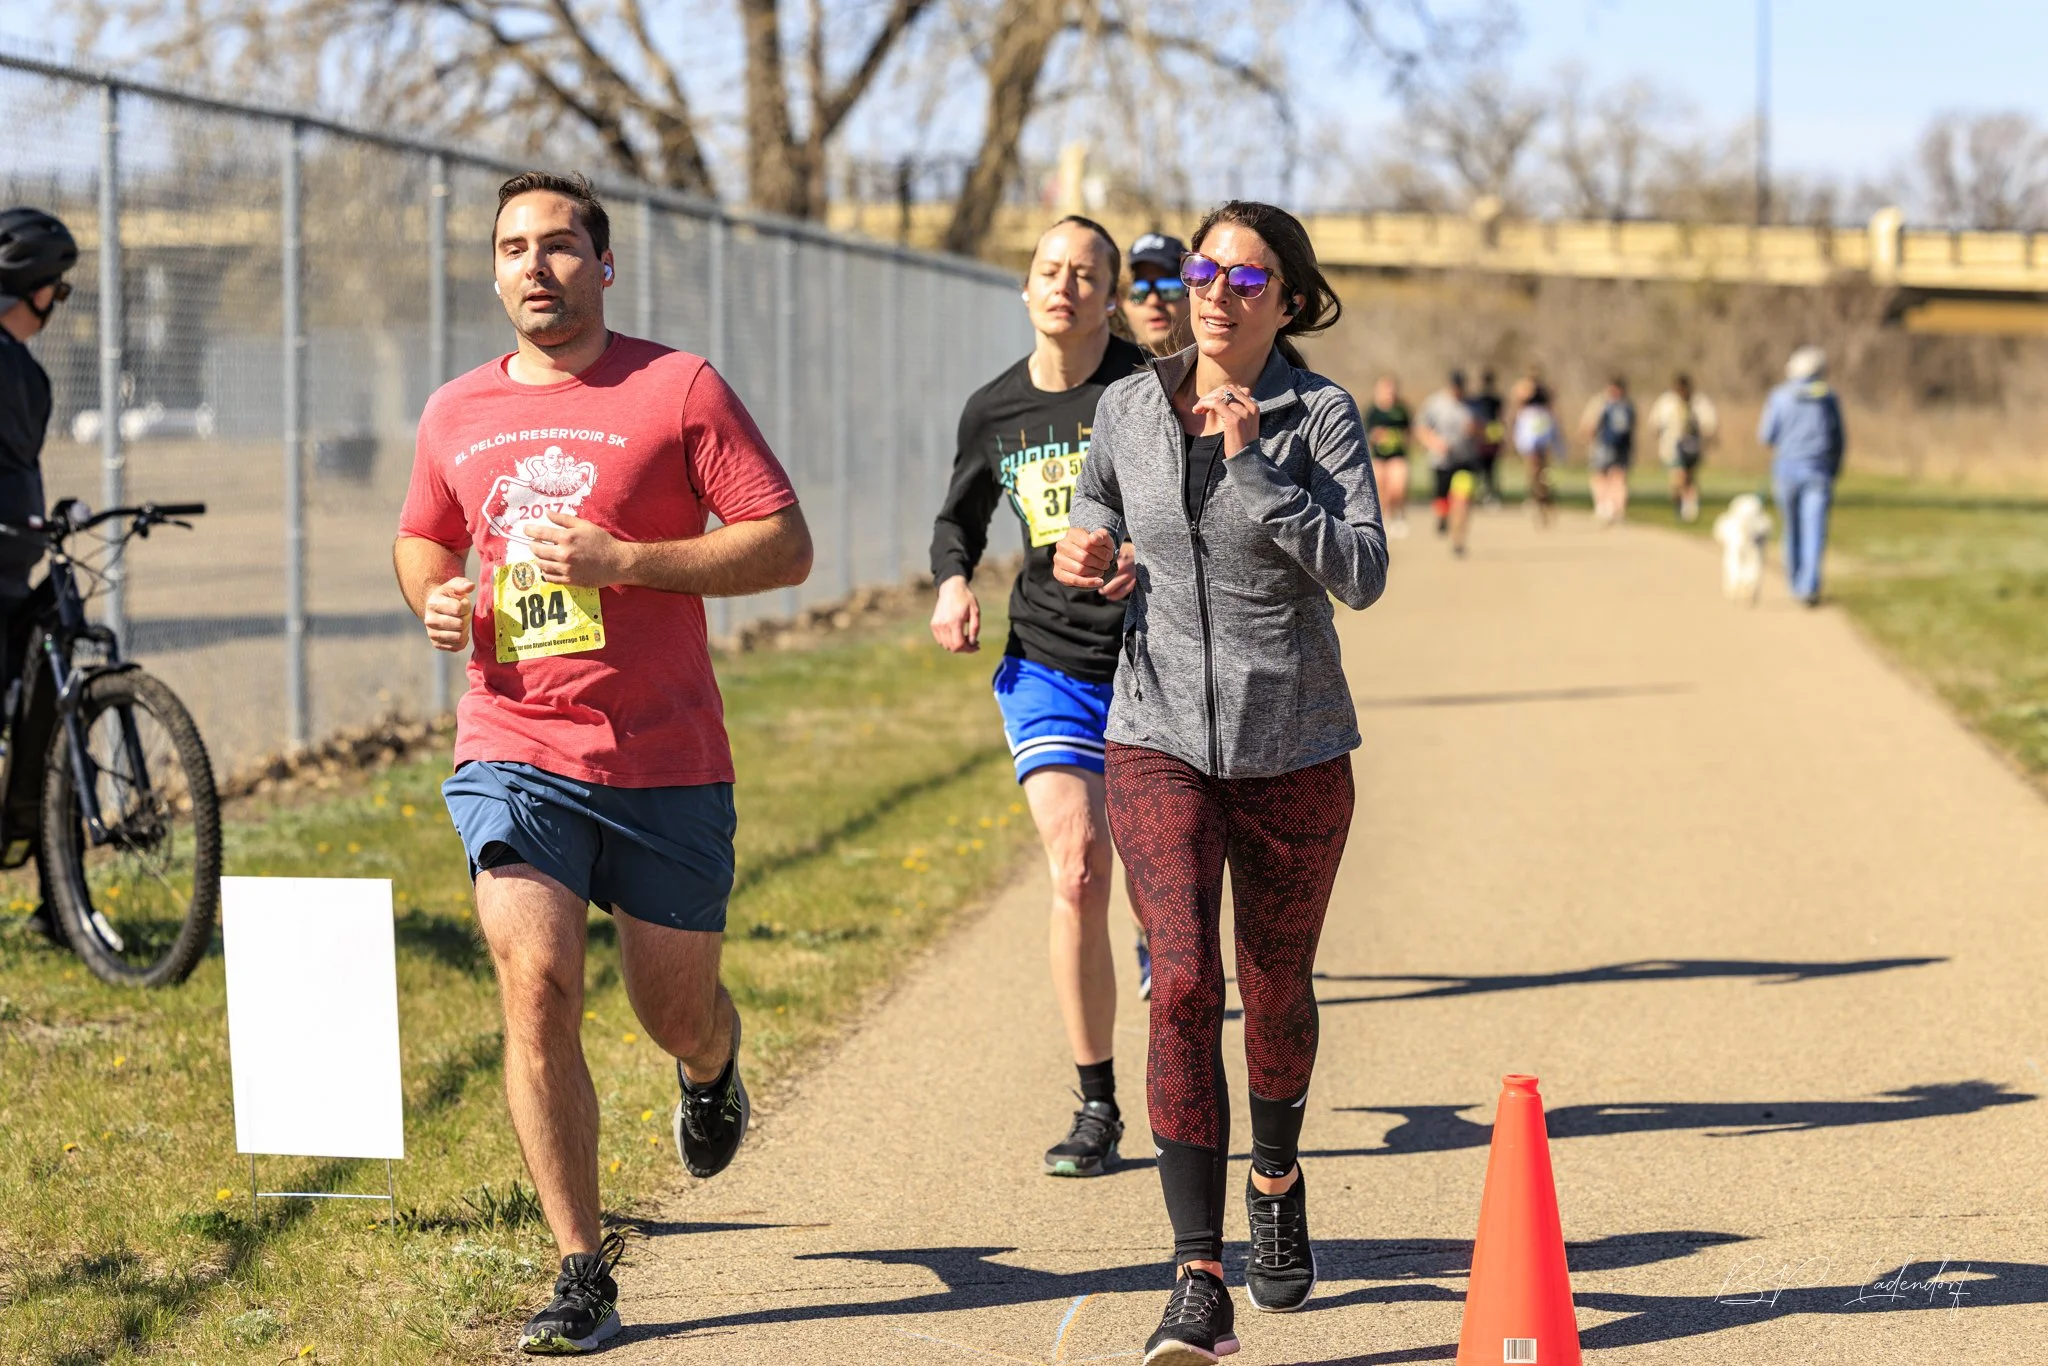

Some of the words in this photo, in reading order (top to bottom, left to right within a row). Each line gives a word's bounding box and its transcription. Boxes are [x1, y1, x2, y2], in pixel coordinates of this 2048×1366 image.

[455, 451, 468, 465] EL
[470, 432, 517, 455] PELÓN
[519, 428, 604, 442] RESERVOIR
[607, 434, 628, 447] 5K
[1044, 486, 1076, 516] 37
[515, 591, 567, 630] 184
[533, 641, 552, 649] Atypical
[553, 636, 578, 645] Beverage
